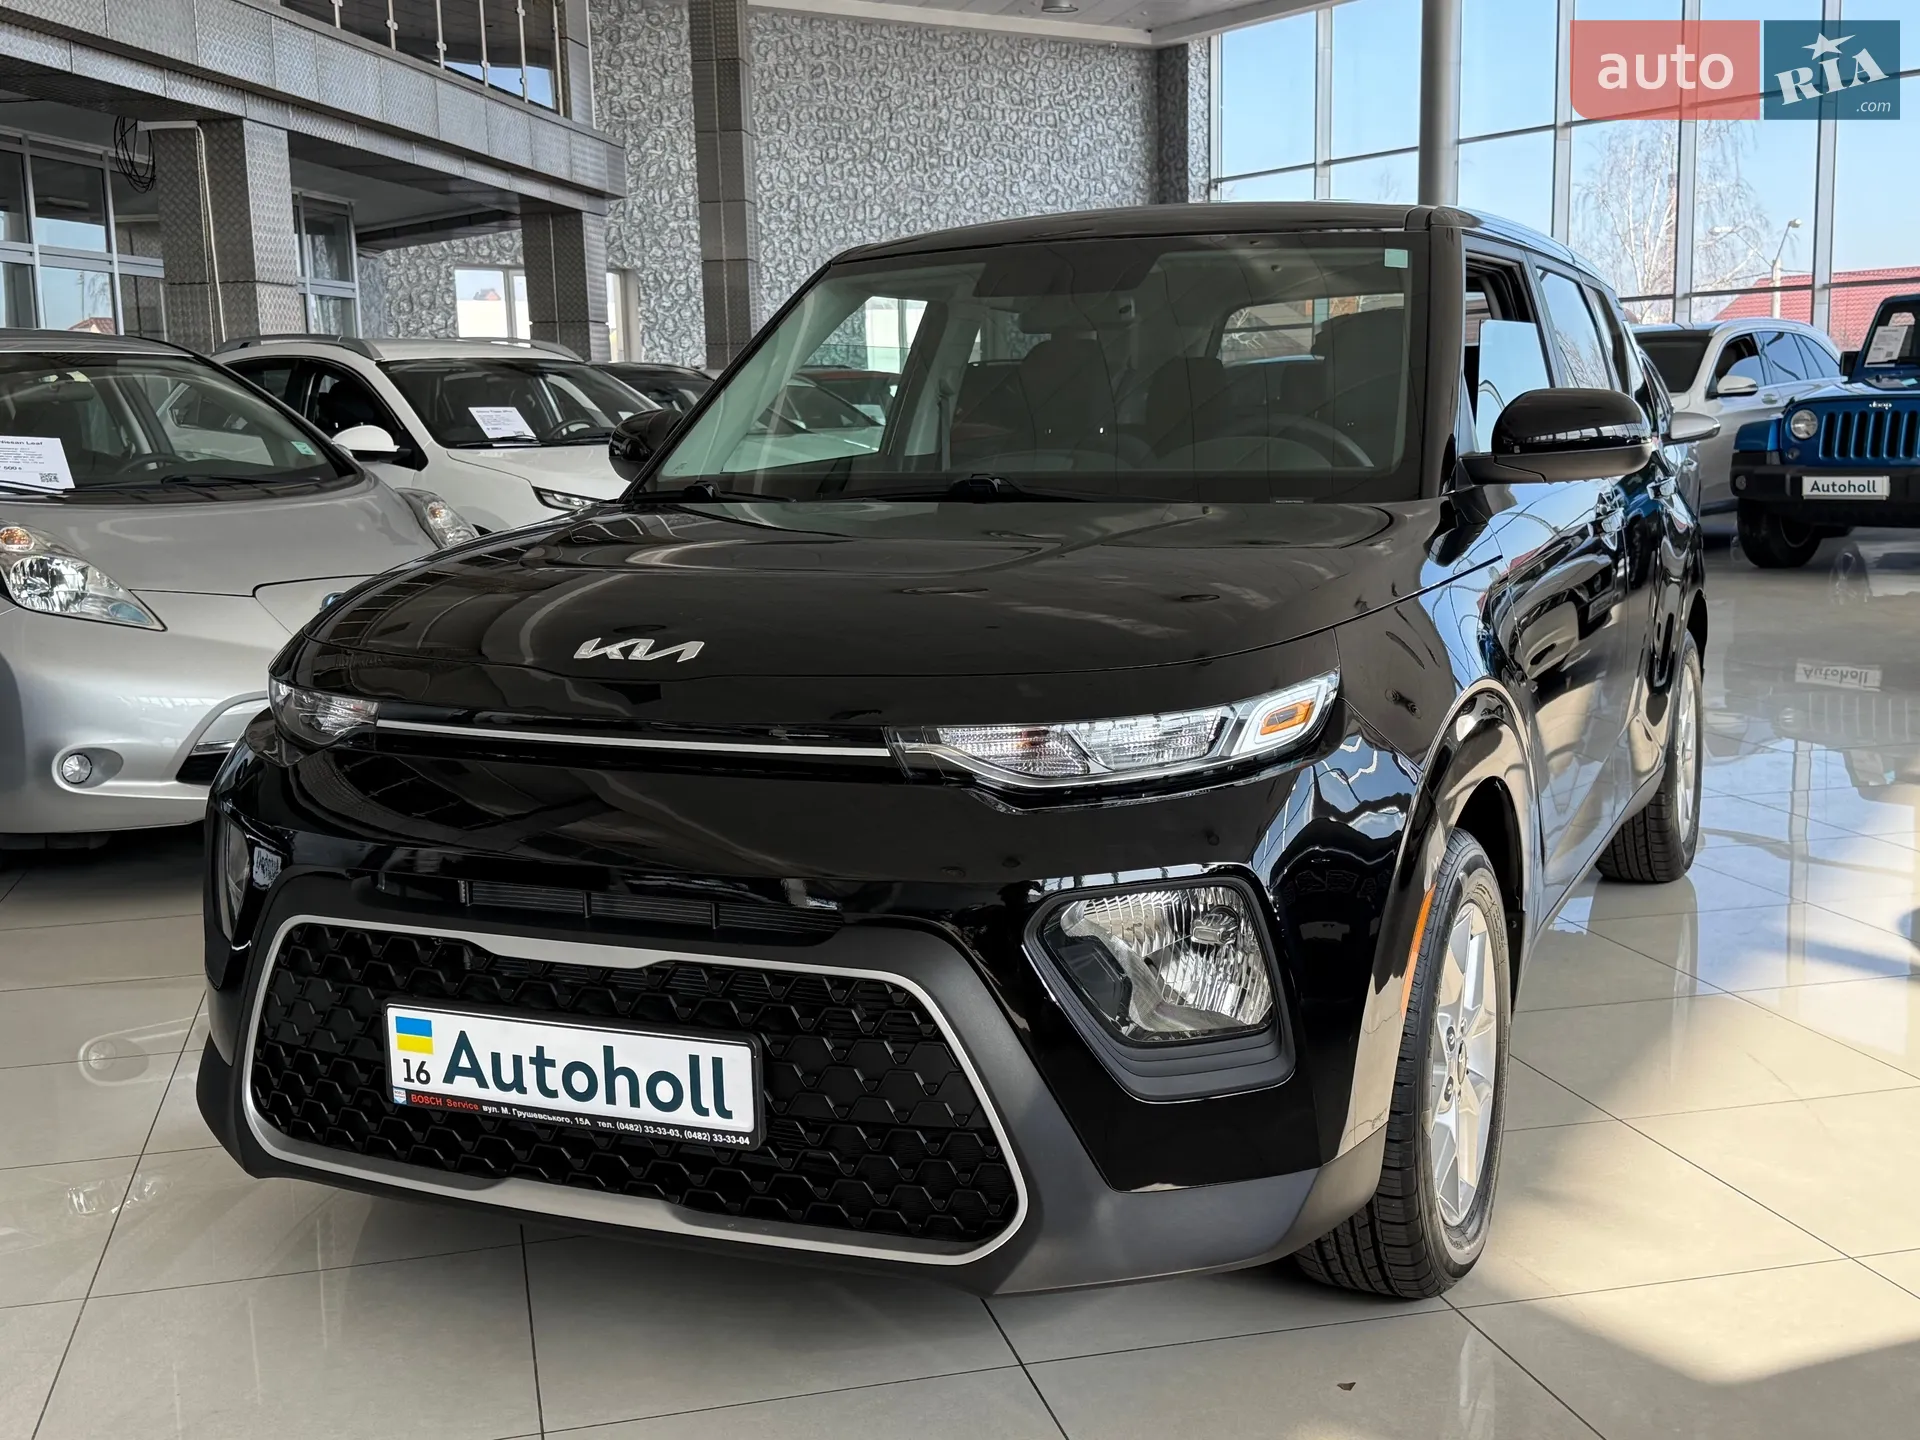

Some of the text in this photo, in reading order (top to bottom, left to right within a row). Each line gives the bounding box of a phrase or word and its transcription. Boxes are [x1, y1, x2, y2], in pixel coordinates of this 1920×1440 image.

[1810, 480, 1877, 493] Autoholl
[573, 637, 705, 663] KIA
[402, 1058, 431, 1085] 16
[442, 1030, 733, 1120] Autoholl
[410, 1093, 443, 1107] BOSCH
[446, 1098, 479, 1111] Service
[616, 1121, 643, 1133] (0482)
[644, 1125, 683, 1139] 33-33-03,
[684, 1129, 711, 1142] (0482)
[712, 1133, 750, 1146] 33-33-04
